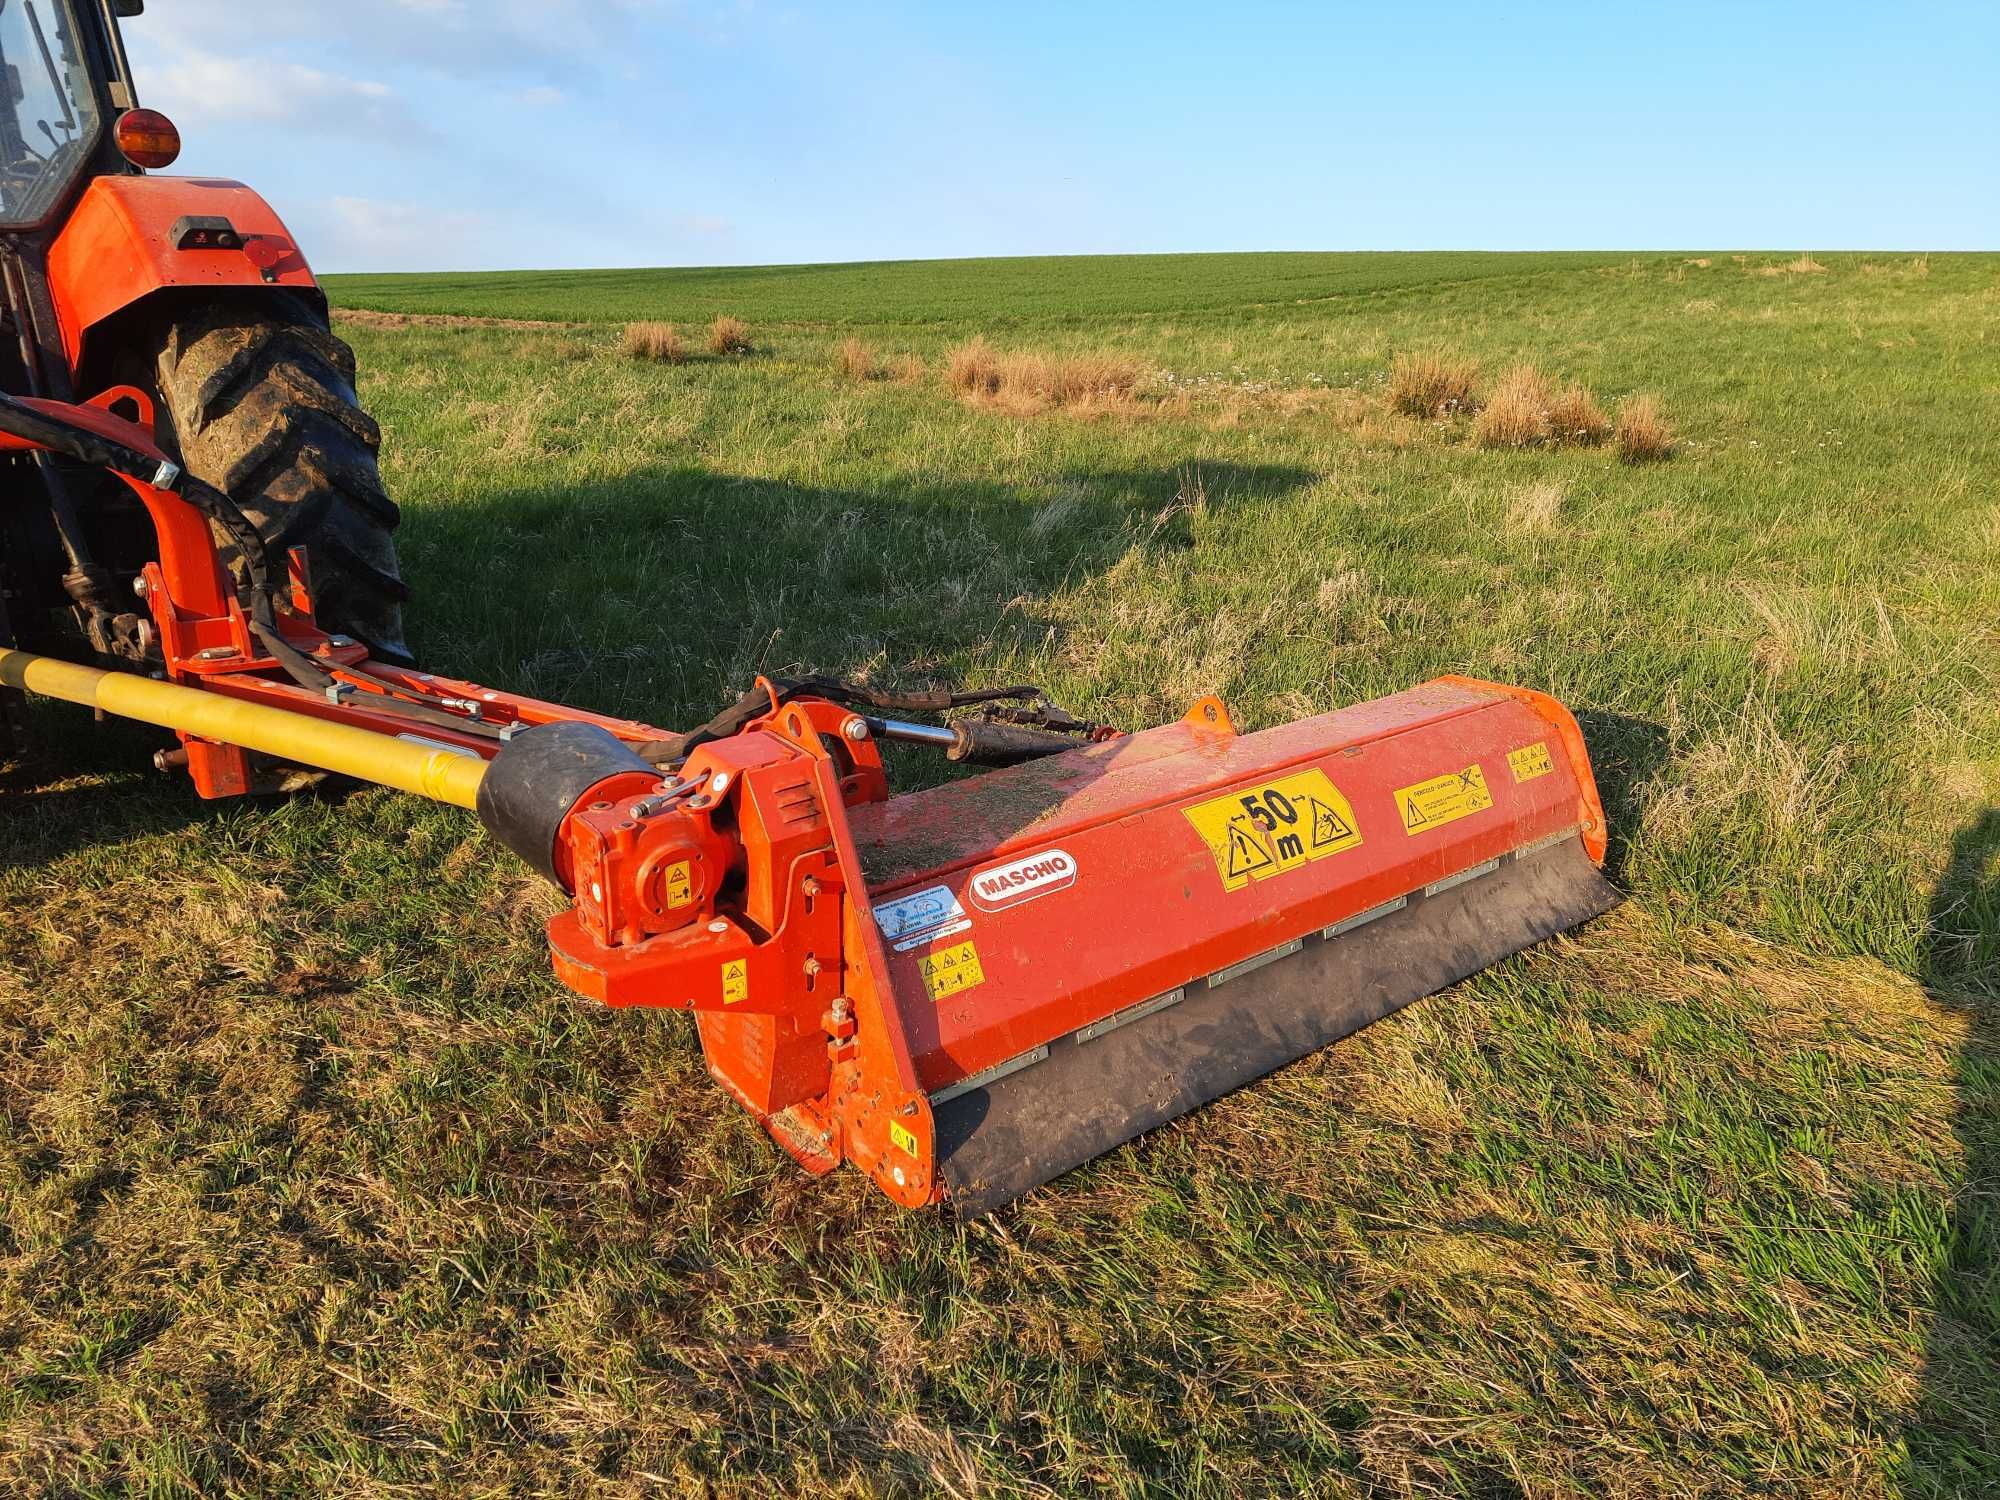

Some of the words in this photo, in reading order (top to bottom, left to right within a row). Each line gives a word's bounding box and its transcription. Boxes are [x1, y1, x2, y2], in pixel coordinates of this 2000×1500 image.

[1239, 789, 1298, 831] 50
[1277, 833, 1304, 860] m
[979, 857, 1068, 896] MASCHIO
